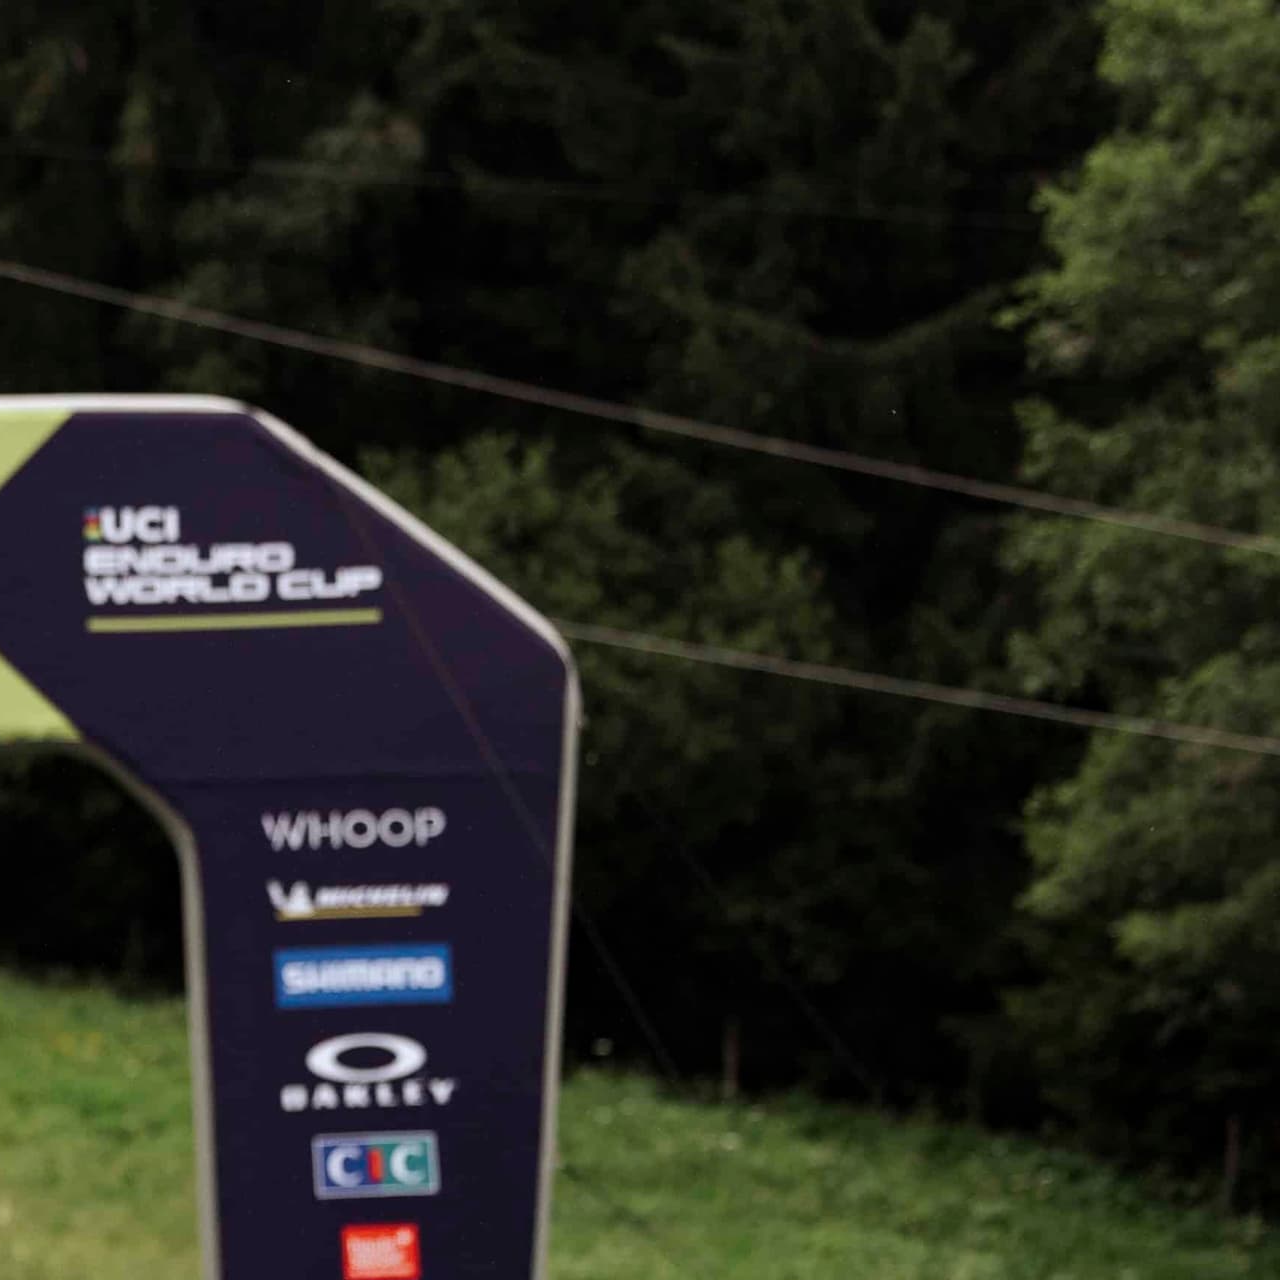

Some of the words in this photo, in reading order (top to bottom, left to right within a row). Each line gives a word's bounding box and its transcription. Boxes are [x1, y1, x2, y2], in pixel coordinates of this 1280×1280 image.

[99, 507, 180, 543] UCI
[83, 542, 295, 576] ENDURO
[84, 574, 270, 605] WORLD
[276, 566, 383, 600] CUP
[261, 806, 447, 851] WHOOP
[326, 1142, 429, 1188] CIC
